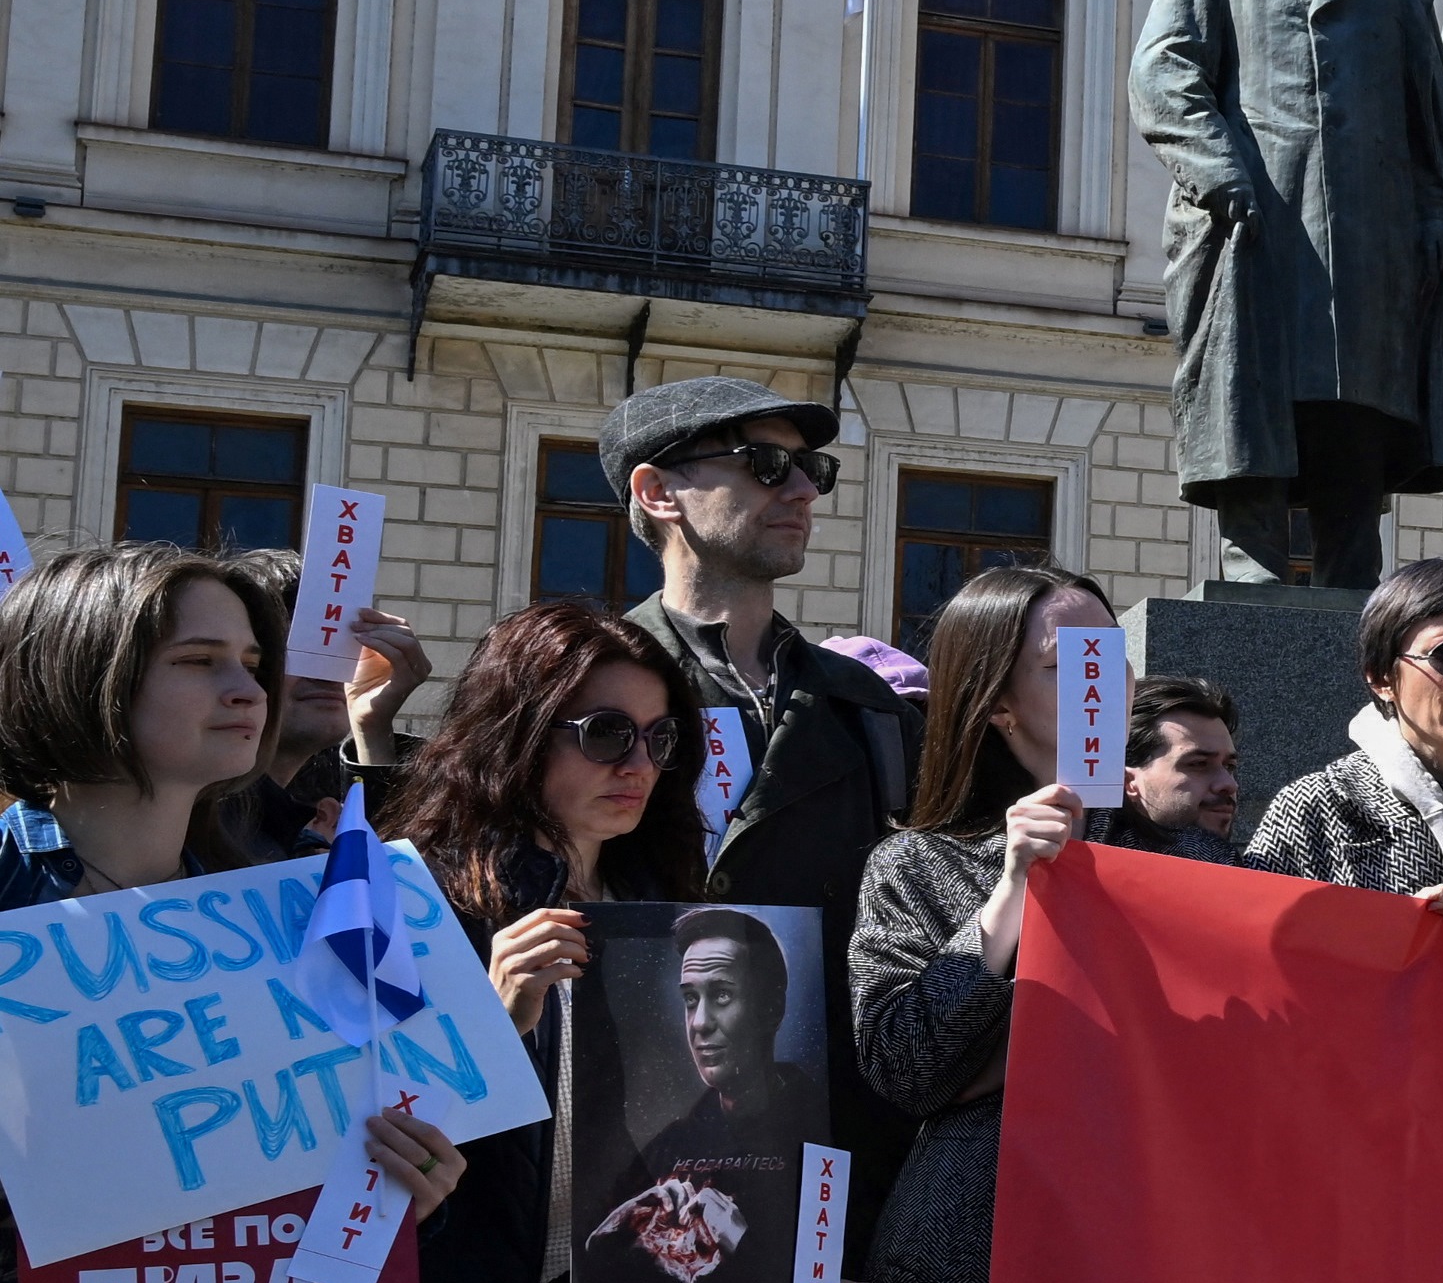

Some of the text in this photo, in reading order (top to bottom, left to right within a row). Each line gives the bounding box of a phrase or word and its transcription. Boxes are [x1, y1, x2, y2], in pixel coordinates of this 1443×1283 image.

[321, 499, 359, 647] ХВАТИТ
[703, 718, 734, 824] ХВАТ
[1082, 638, 1102, 777] ХВАТИТ
[0, 854, 444, 1027] RUSSIAS
[76, 992, 242, 1107] ARE
